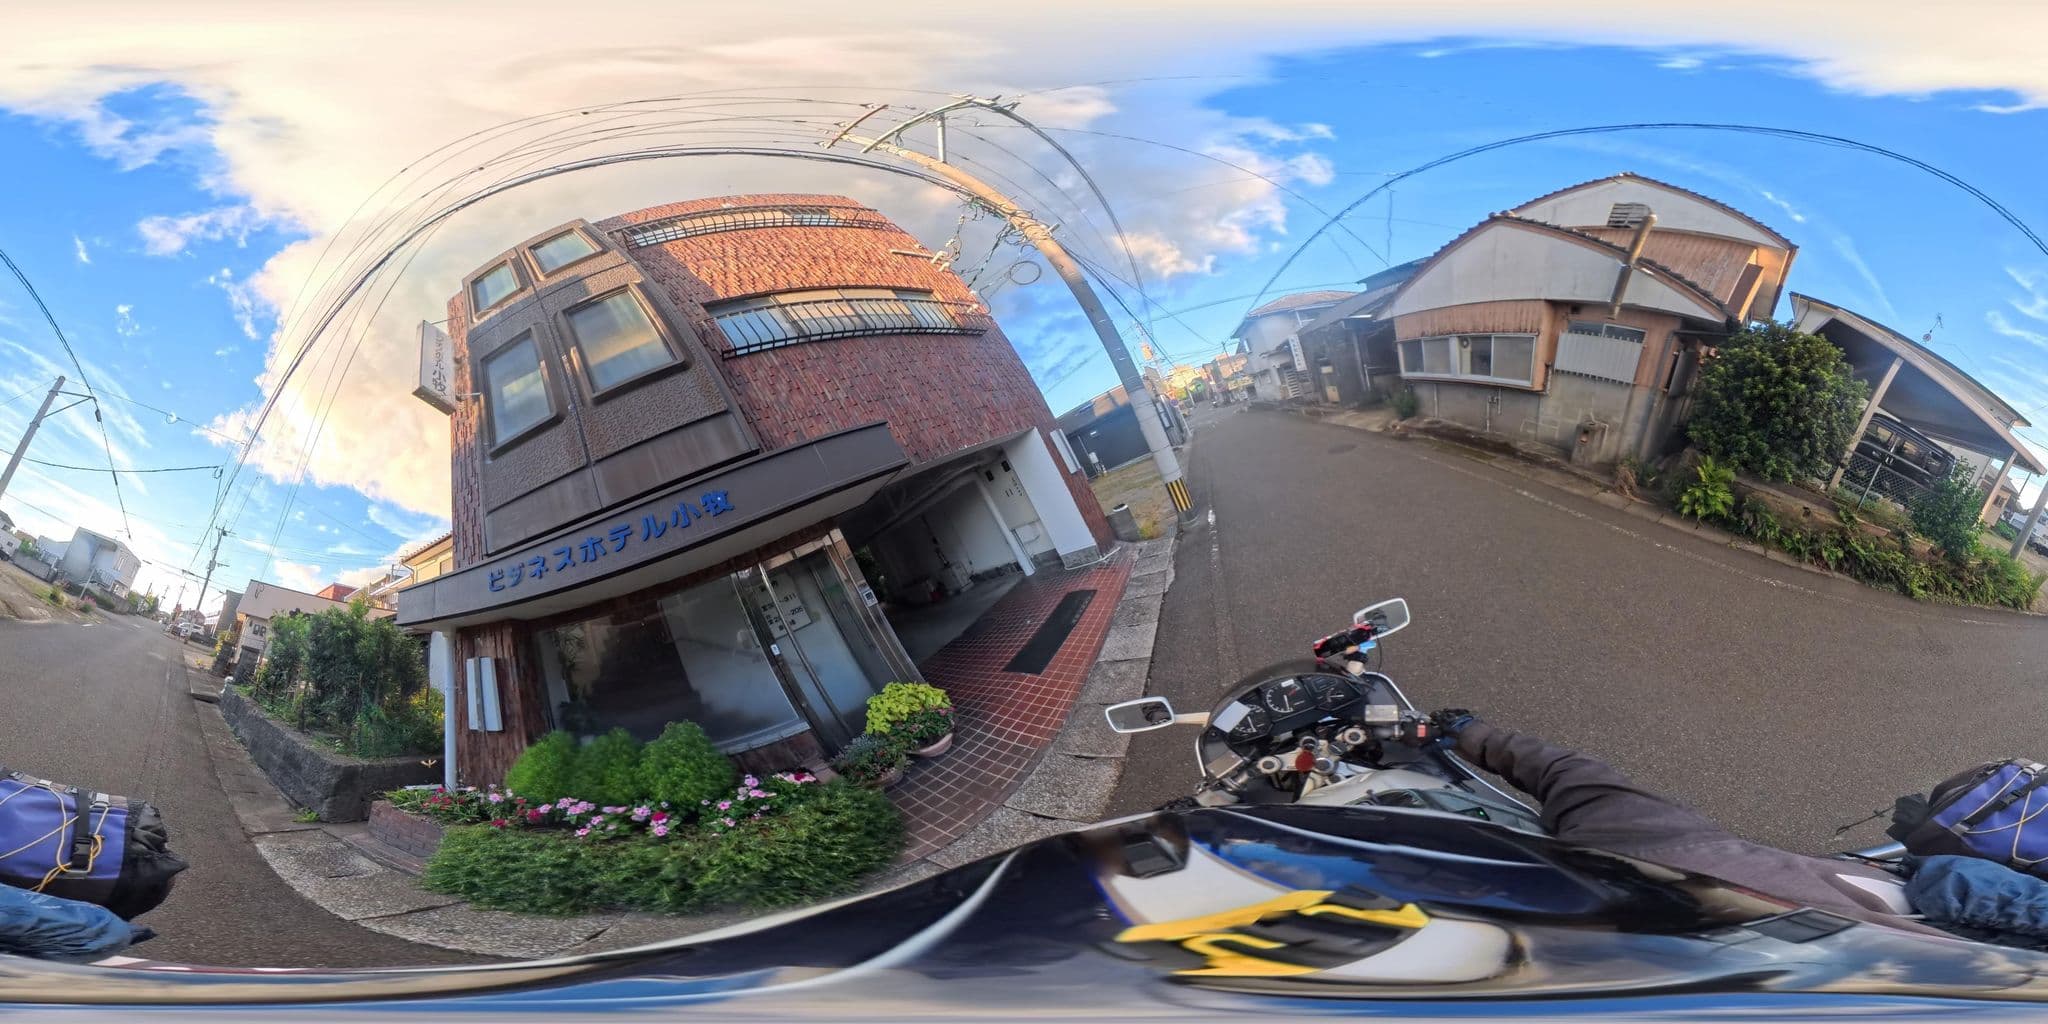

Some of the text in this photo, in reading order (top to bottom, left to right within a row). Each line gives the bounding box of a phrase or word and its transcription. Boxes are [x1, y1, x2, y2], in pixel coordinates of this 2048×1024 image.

[487, 489, 735, 592] ビジネスホテル小牧
